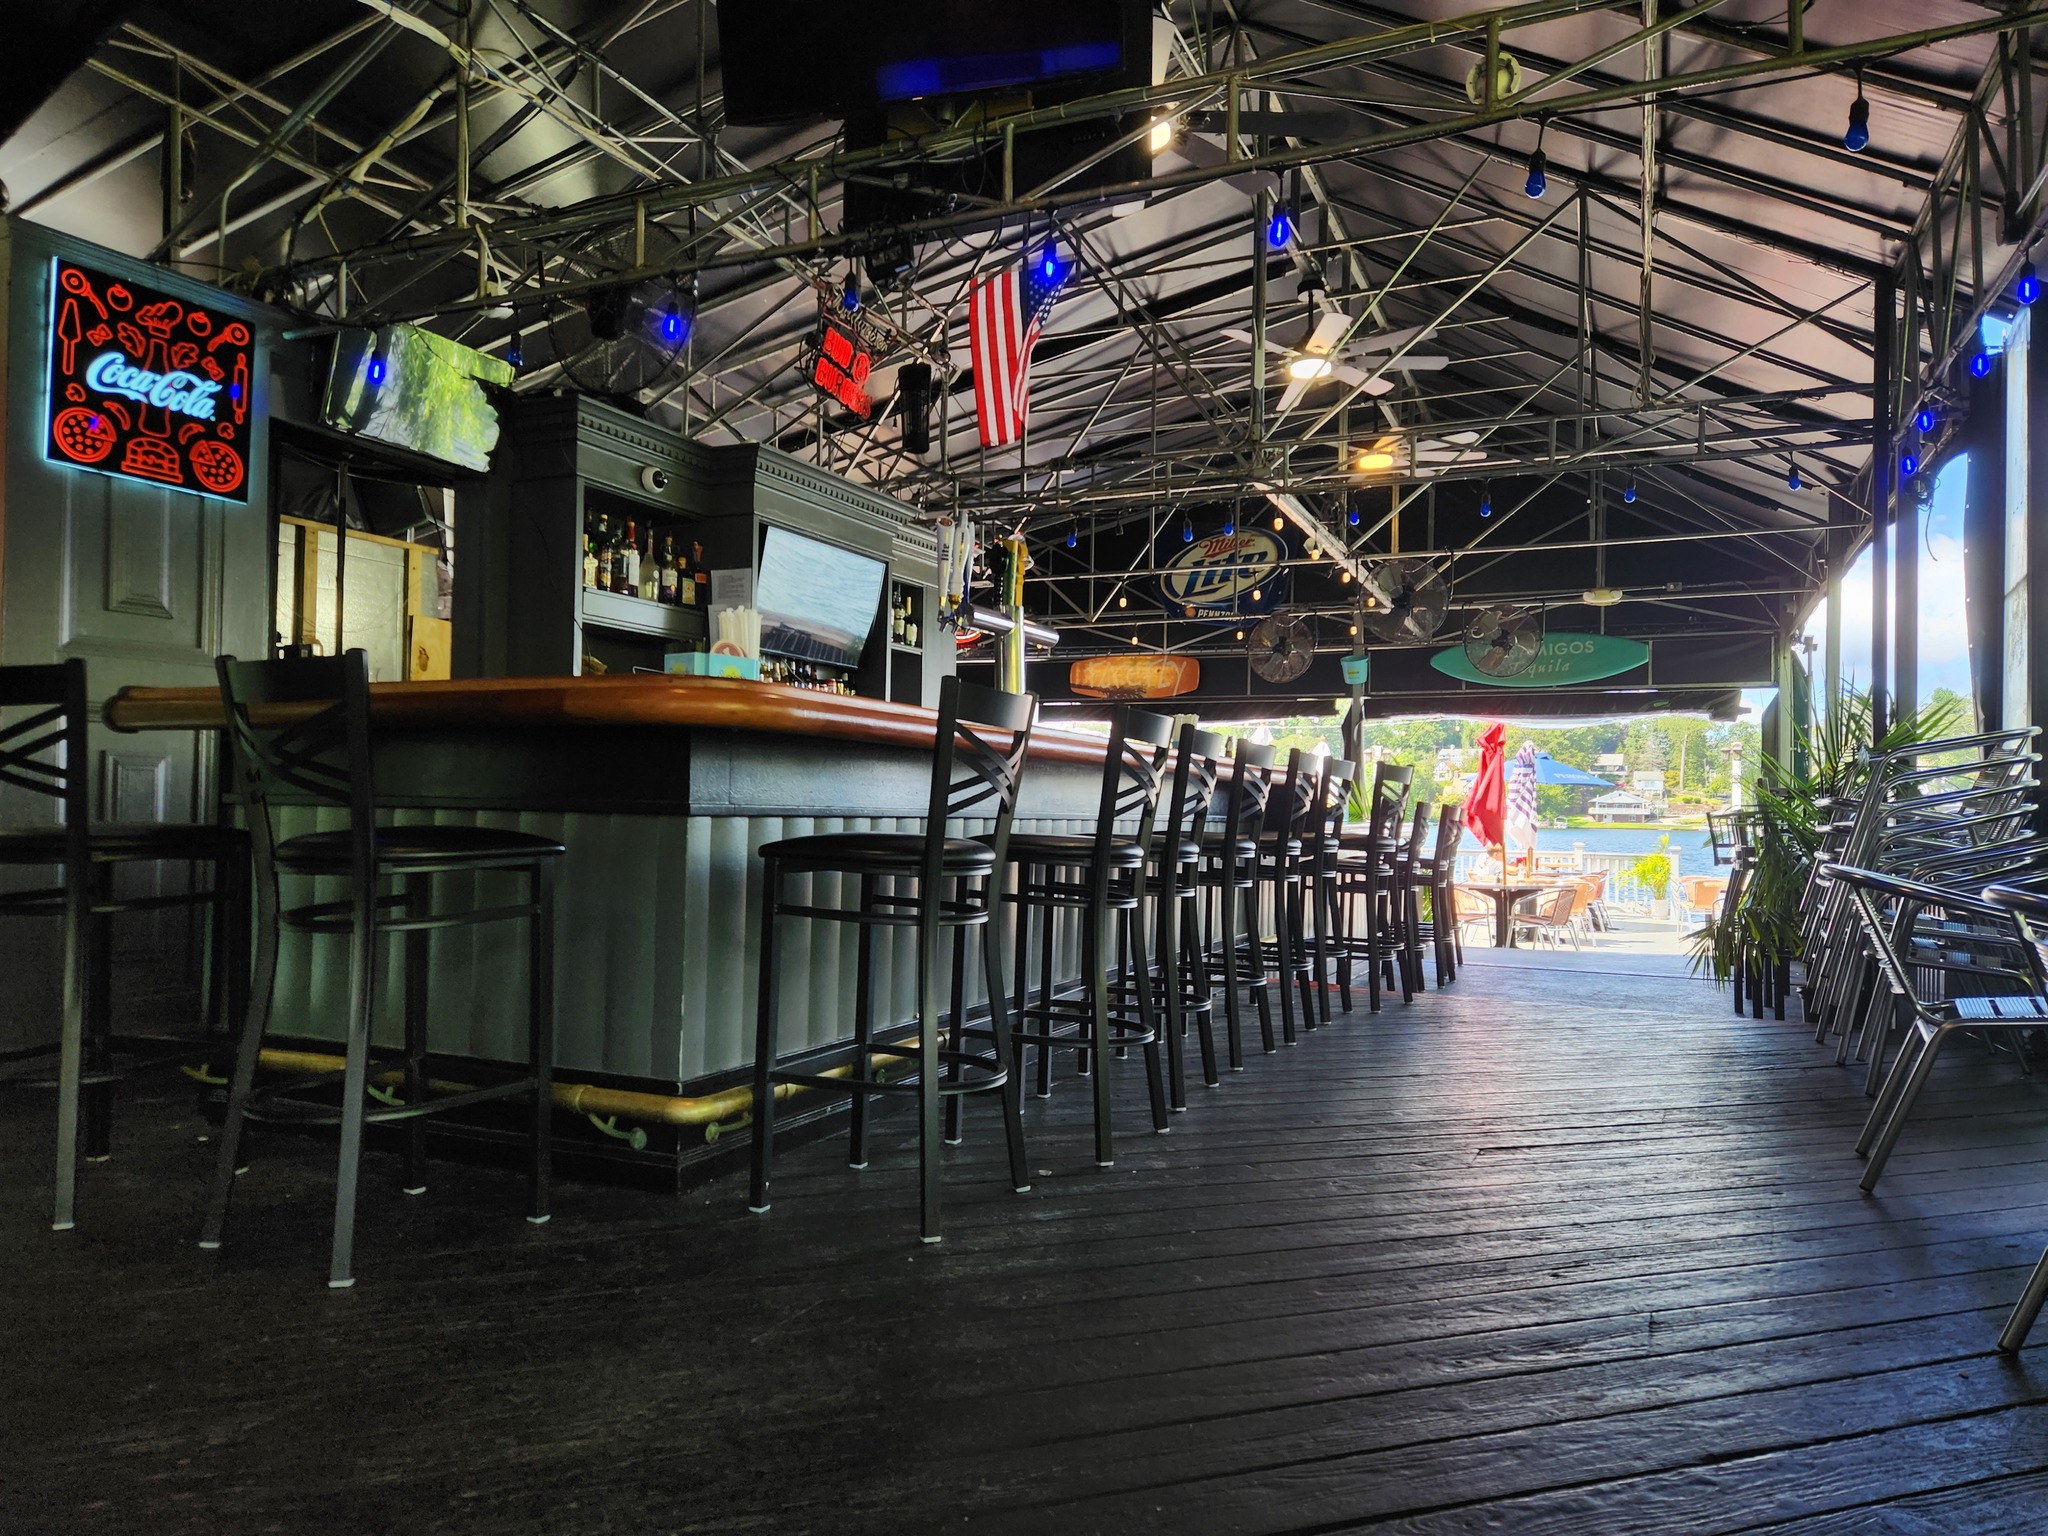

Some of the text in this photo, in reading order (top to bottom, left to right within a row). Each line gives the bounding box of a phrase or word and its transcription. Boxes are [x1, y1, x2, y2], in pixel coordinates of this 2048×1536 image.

[823, 326, 854, 369] BUD
[86, 352, 222, 421] Coca-Cola
[1181, 550, 1268, 599] Lite
[1197, 608, 1238, 621] PENNZOI
[1509, 659, 1570, 678] Tquila
